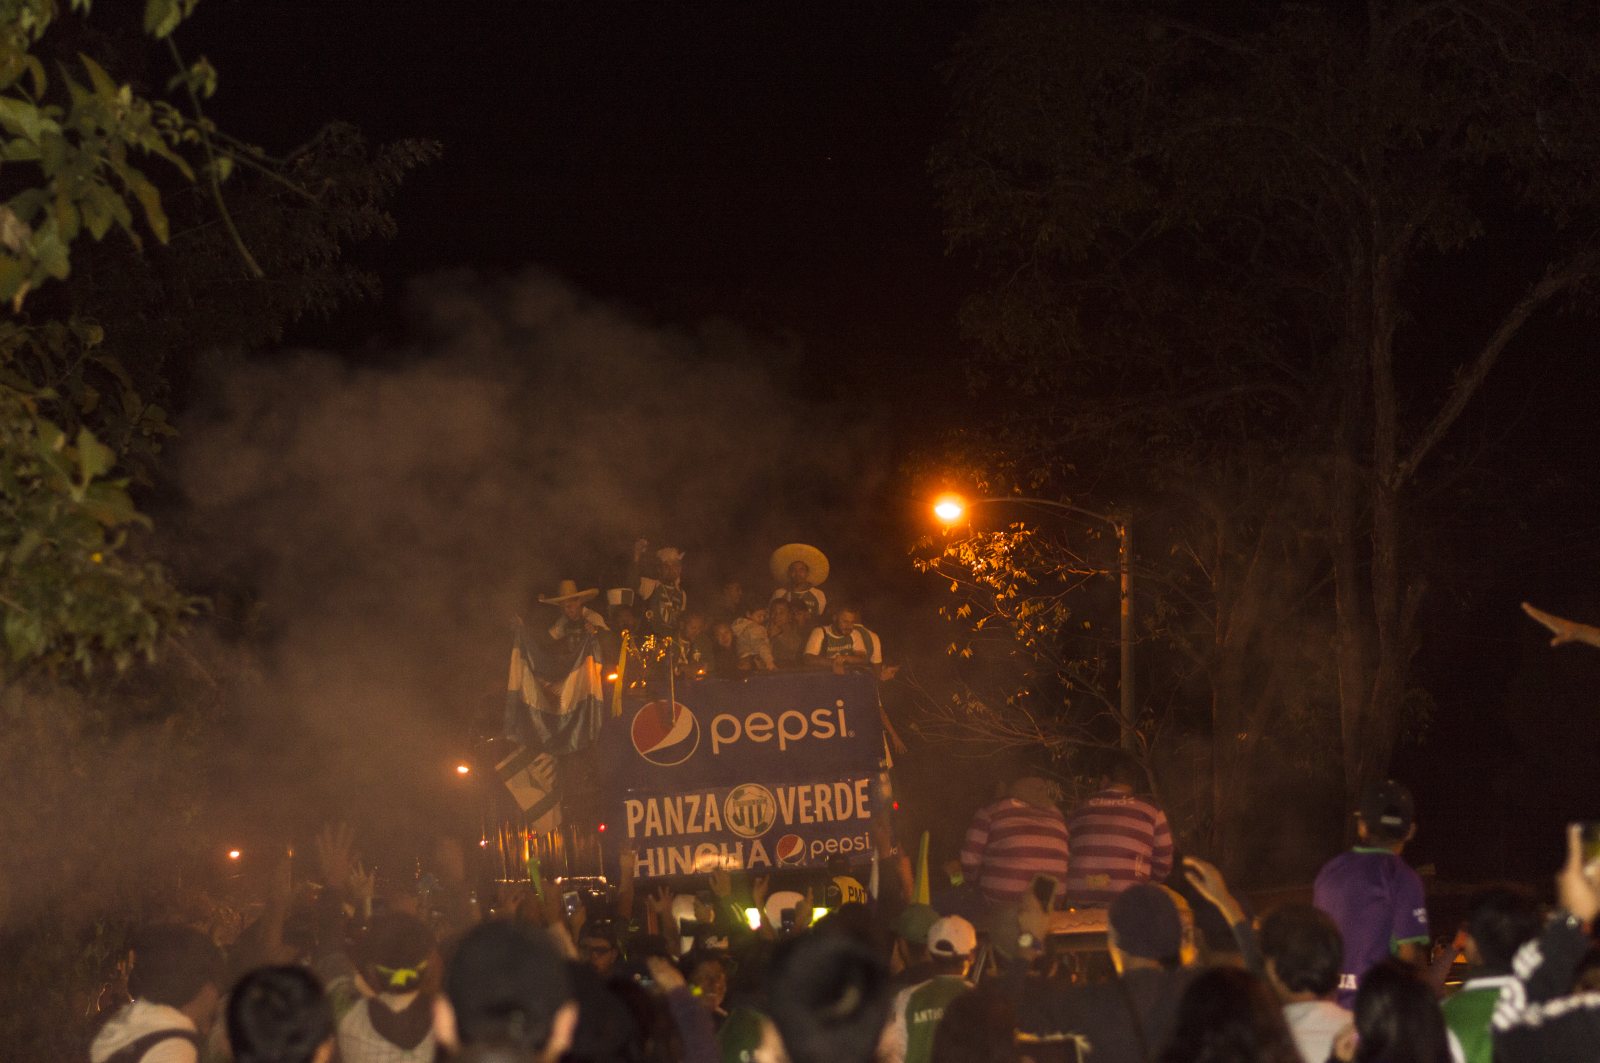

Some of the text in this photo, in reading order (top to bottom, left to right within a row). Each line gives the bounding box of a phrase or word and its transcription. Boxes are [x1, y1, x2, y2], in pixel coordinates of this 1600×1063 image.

[711, 701, 847, 754] pepsi
[626, 780, 871, 838] PANZA VERDE
[810, 833, 870, 859] pepsi
